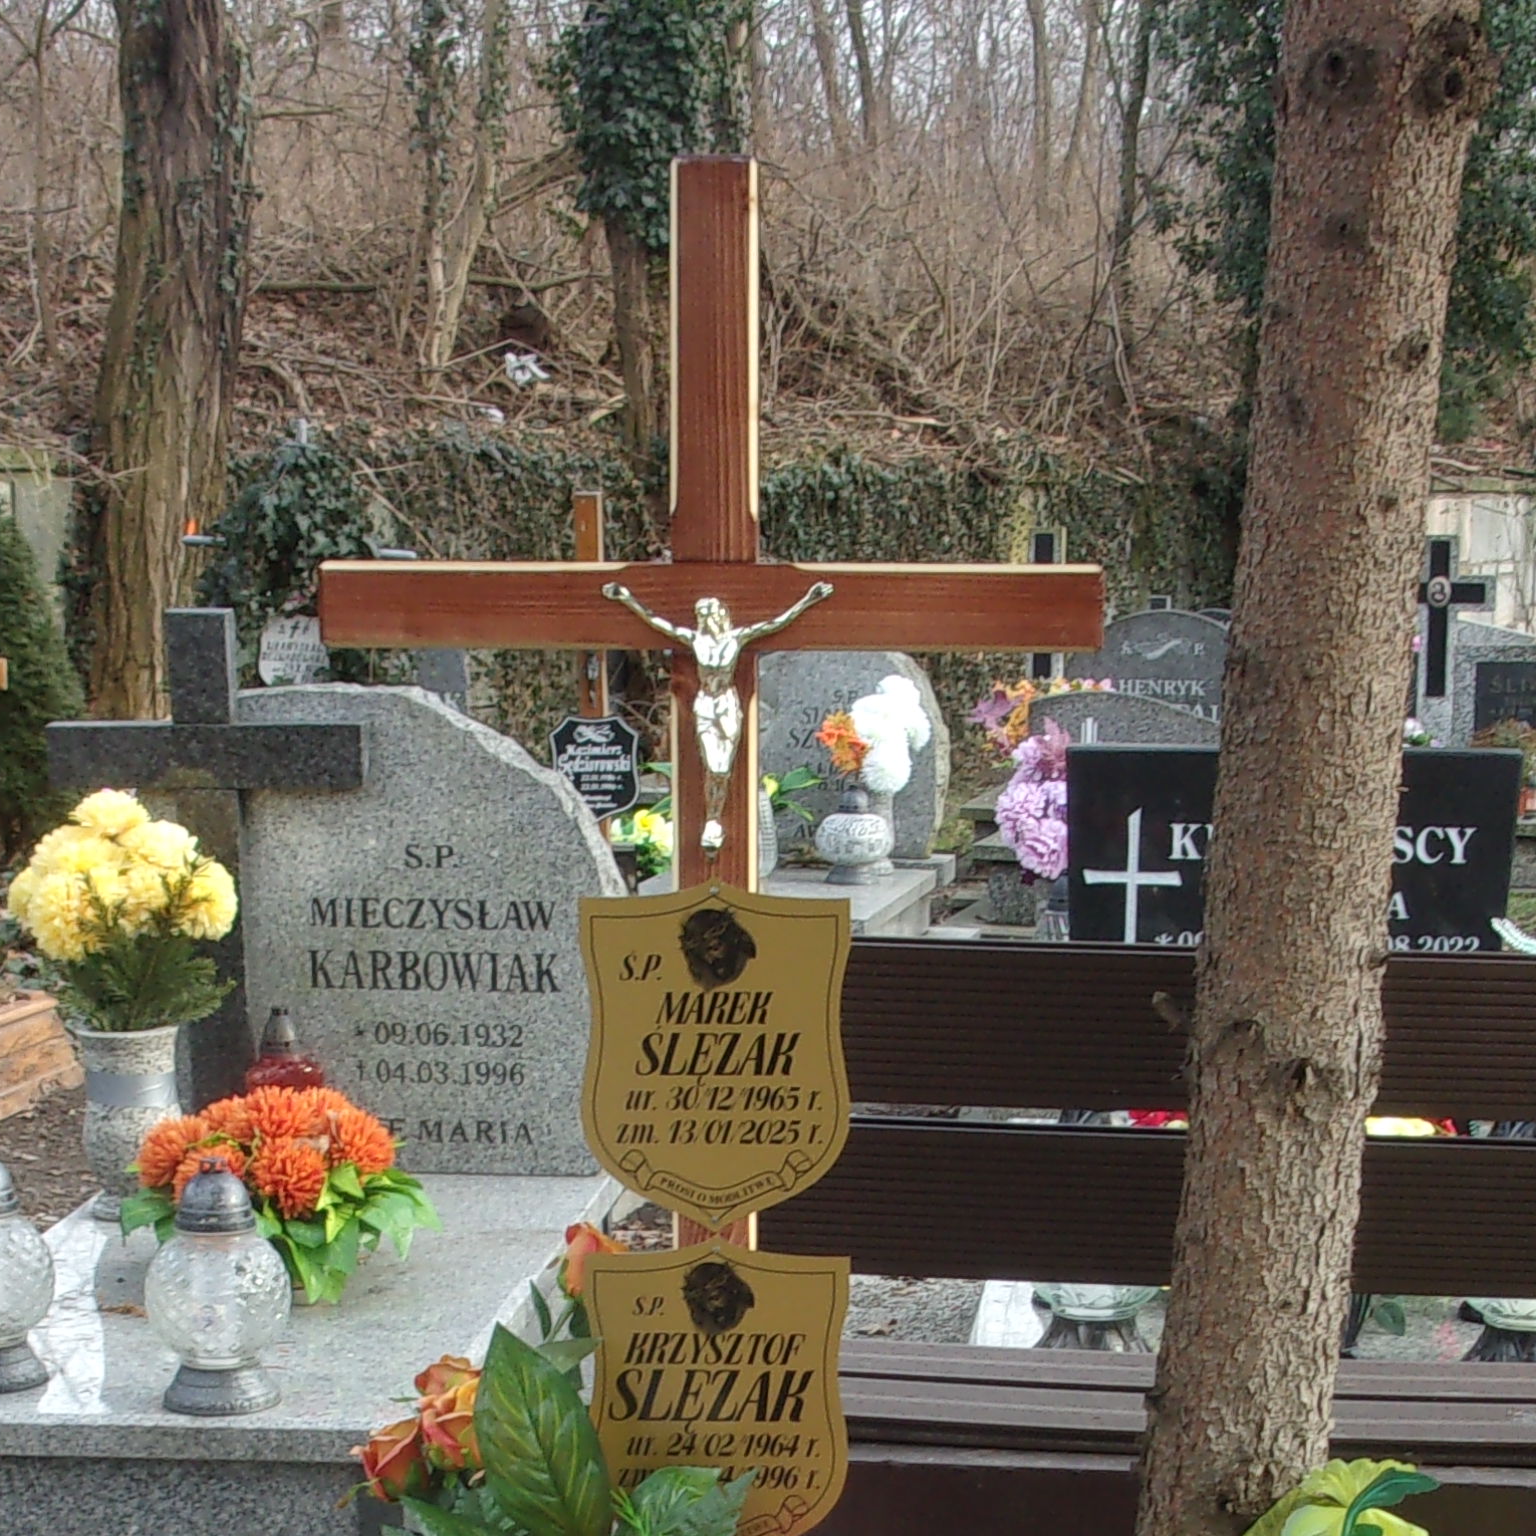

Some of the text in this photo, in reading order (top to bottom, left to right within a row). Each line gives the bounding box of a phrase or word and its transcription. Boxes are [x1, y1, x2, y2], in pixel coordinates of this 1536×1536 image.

[1118, 678, 1206, 697] HENRYK
[309, 896, 556, 932] MIECZYSŁAW
[306, 948, 562, 994] KARBOWIAK
[618, 949, 664, 982] Ś.P.
[655, 991, 774, 1025] MAREK
[373, 1020, 524, 1049] 09.06.1932
[635, 1025, 801, 1088] ŚLĘZAK
[374, 1058, 526, 1087] 04.03.1996
[625, 1085, 824, 1112] ur. 30/12/1965 r.
[416, 1118, 534, 1146] MARIA
[615, 1119, 824, 1145] zm. 13/01/2025 r.
[624, 1332, 807, 1366] KRZYSZTOF
[626, 1434, 821, 1458] ur. 24/02/1964 r.
[805, 1470, 822, 1491] r.
